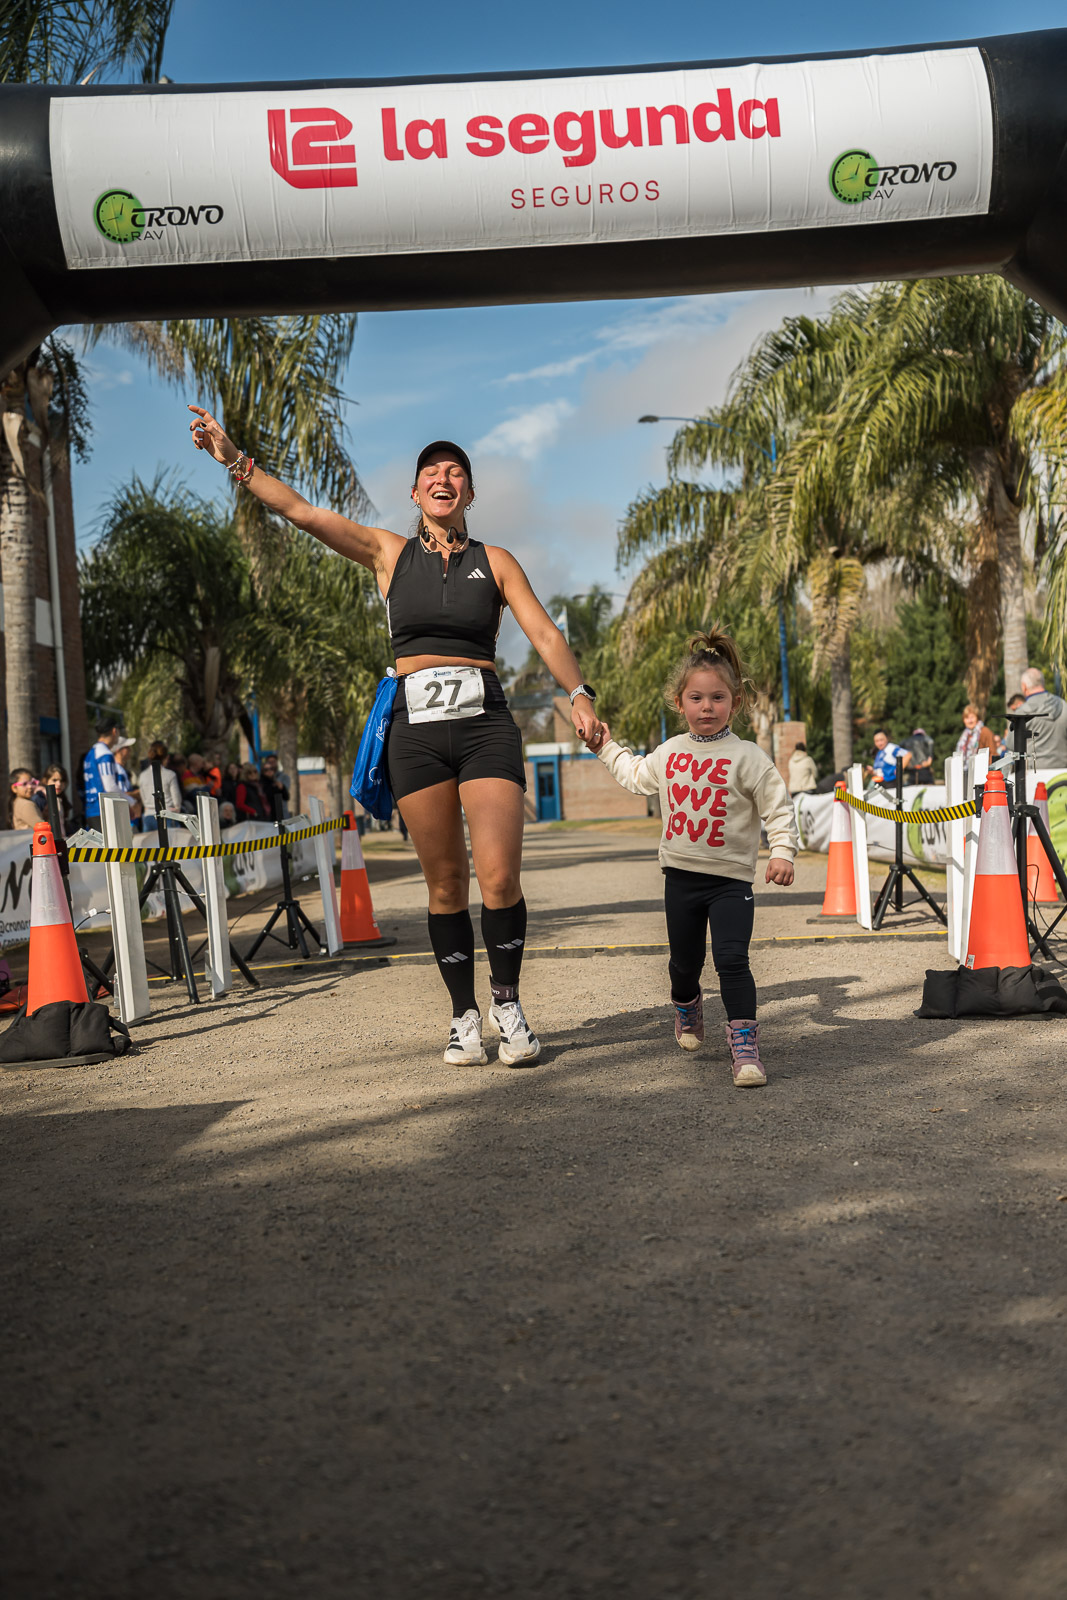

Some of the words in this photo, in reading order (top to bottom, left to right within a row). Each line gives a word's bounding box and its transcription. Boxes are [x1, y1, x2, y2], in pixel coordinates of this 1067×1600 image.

[381, 107, 447, 161] la
[466, 87, 781, 168] segunda
[864, 161, 957, 187] CRONO
[511, 180, 661, 209] SEGUROS
[861, 188, 895, 201] RAV
[130, 204, 224, 228] CRONO
[130, 230, 164, 241] RAV
[424, 679, 463, 709] 27
[666, 753, 732, 785] LOVE
[666, 811, 726, 848] LOVE
